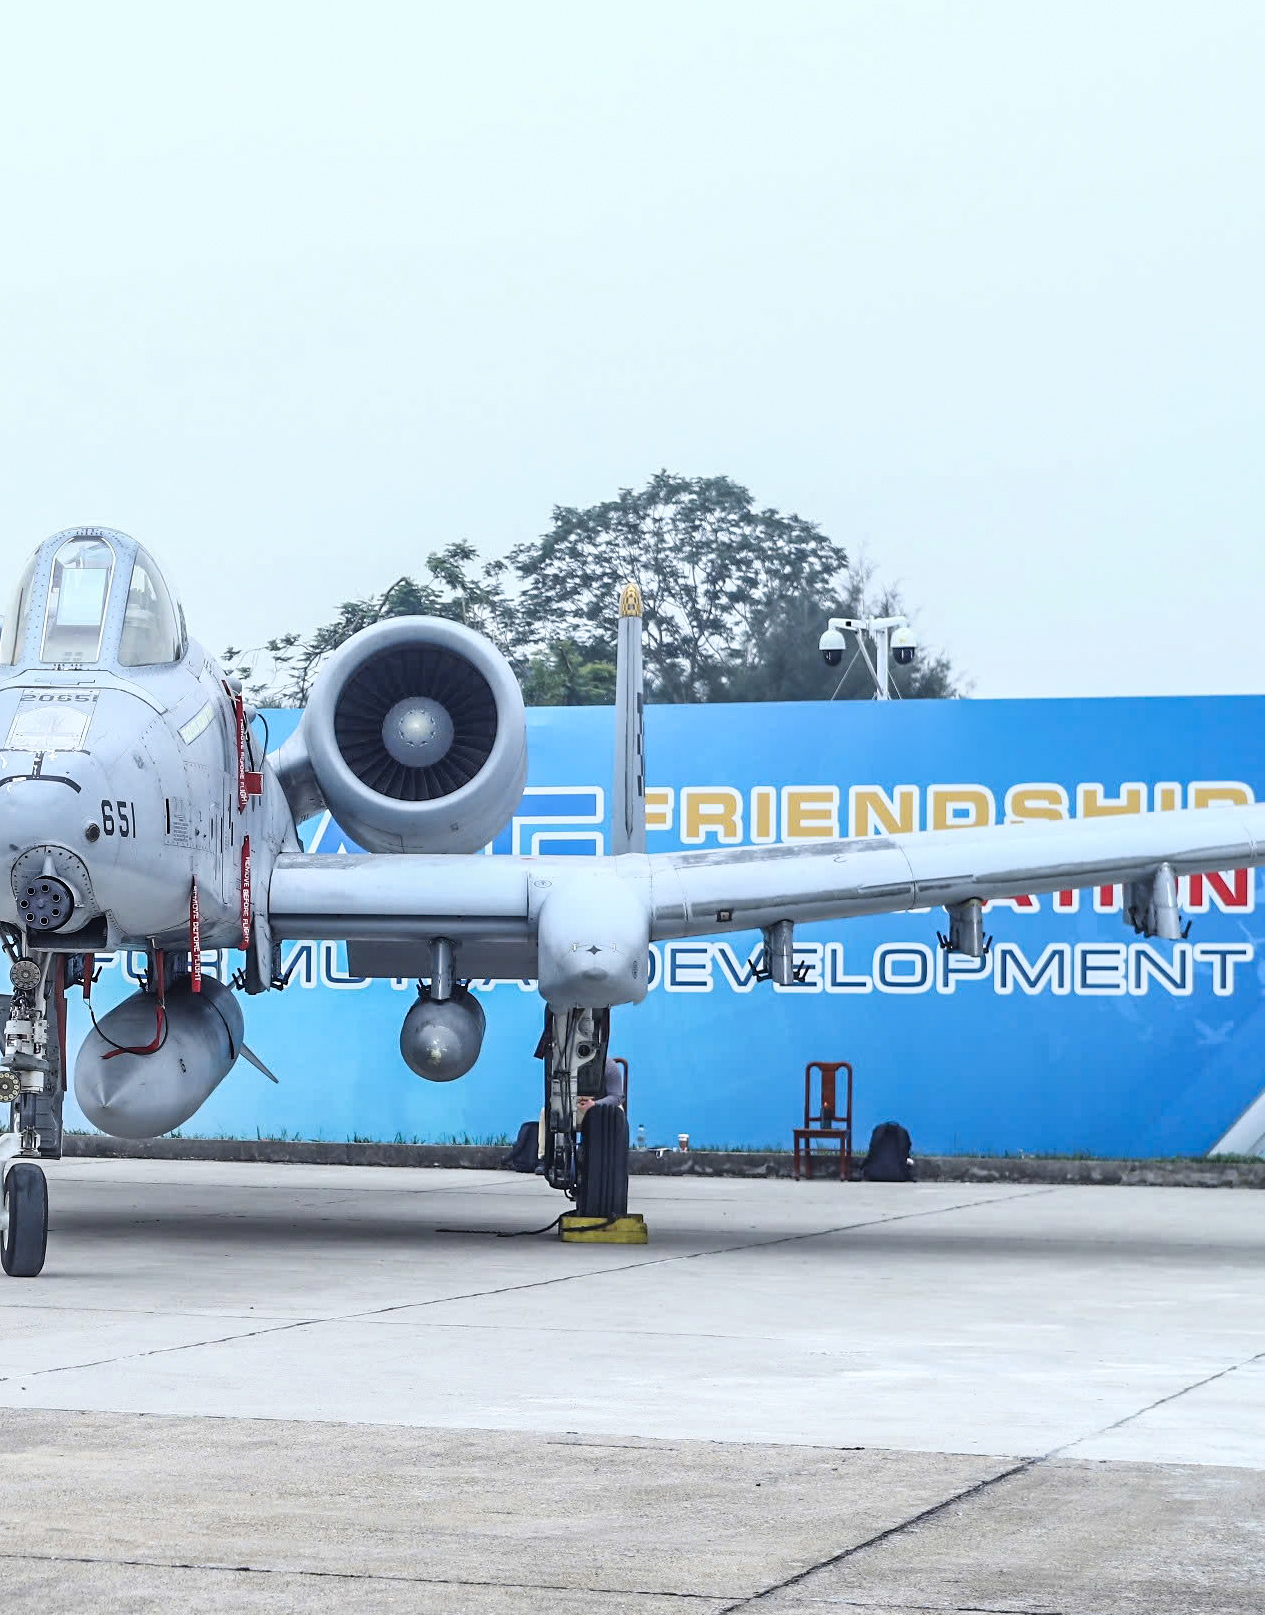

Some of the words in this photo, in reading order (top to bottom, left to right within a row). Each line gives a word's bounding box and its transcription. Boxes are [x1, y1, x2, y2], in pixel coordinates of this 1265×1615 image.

[101, 799, 136, 839] 651
[192, 921, 200, 952] BEFORE
[242, 918, 250, 943] FLIGHT
[193, 954, 201, 982] FLIGHT
[647, 948, 1247, 990] EVELOPMENT
